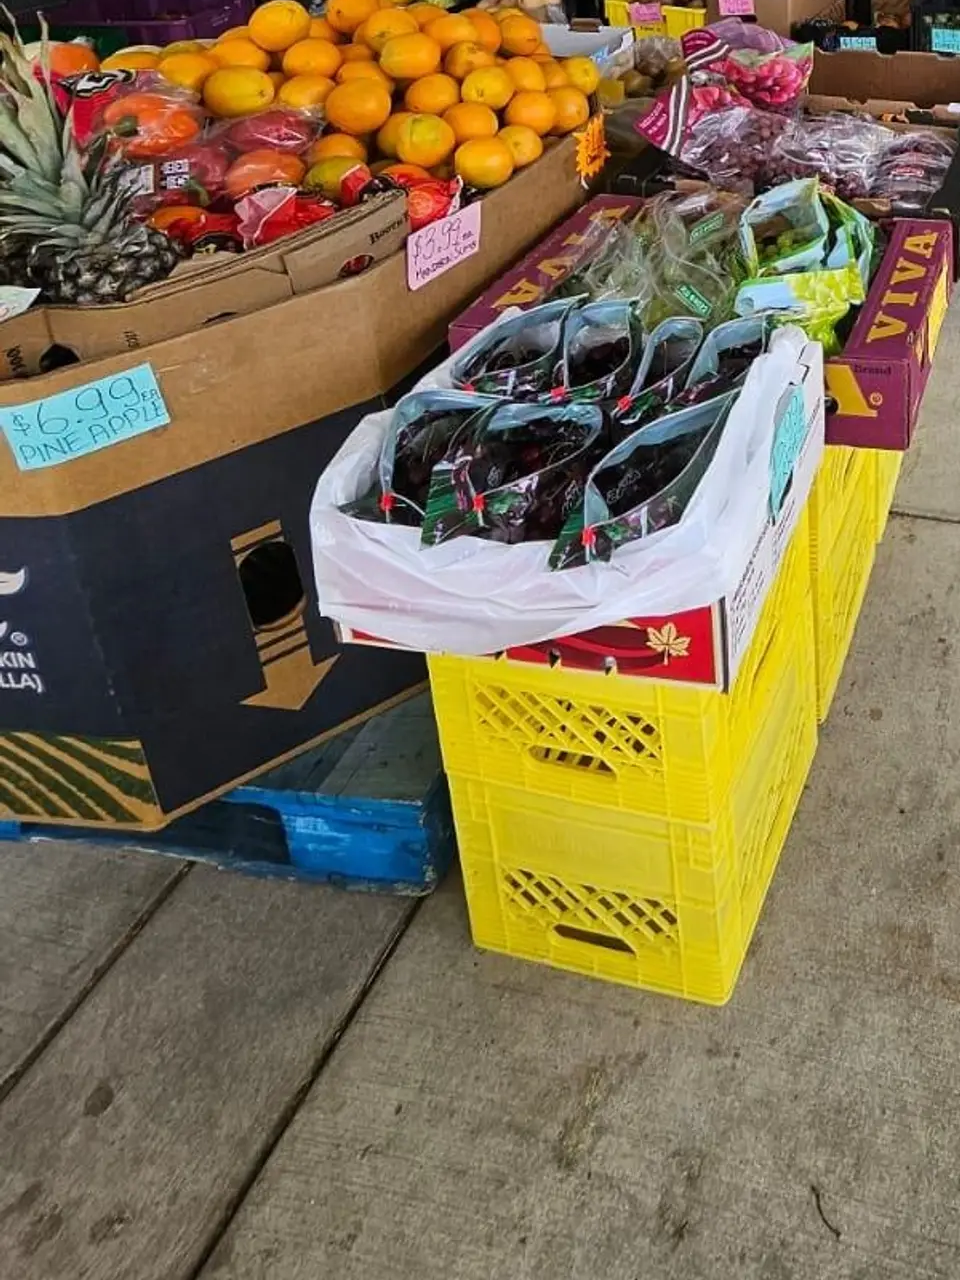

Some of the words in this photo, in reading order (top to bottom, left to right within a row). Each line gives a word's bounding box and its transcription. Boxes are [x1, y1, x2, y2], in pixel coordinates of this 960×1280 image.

[412, 218, 462, 266] $3.99
[865, 229, 939, 344] VIVA
[13, 376, 141, 437] $6.99
